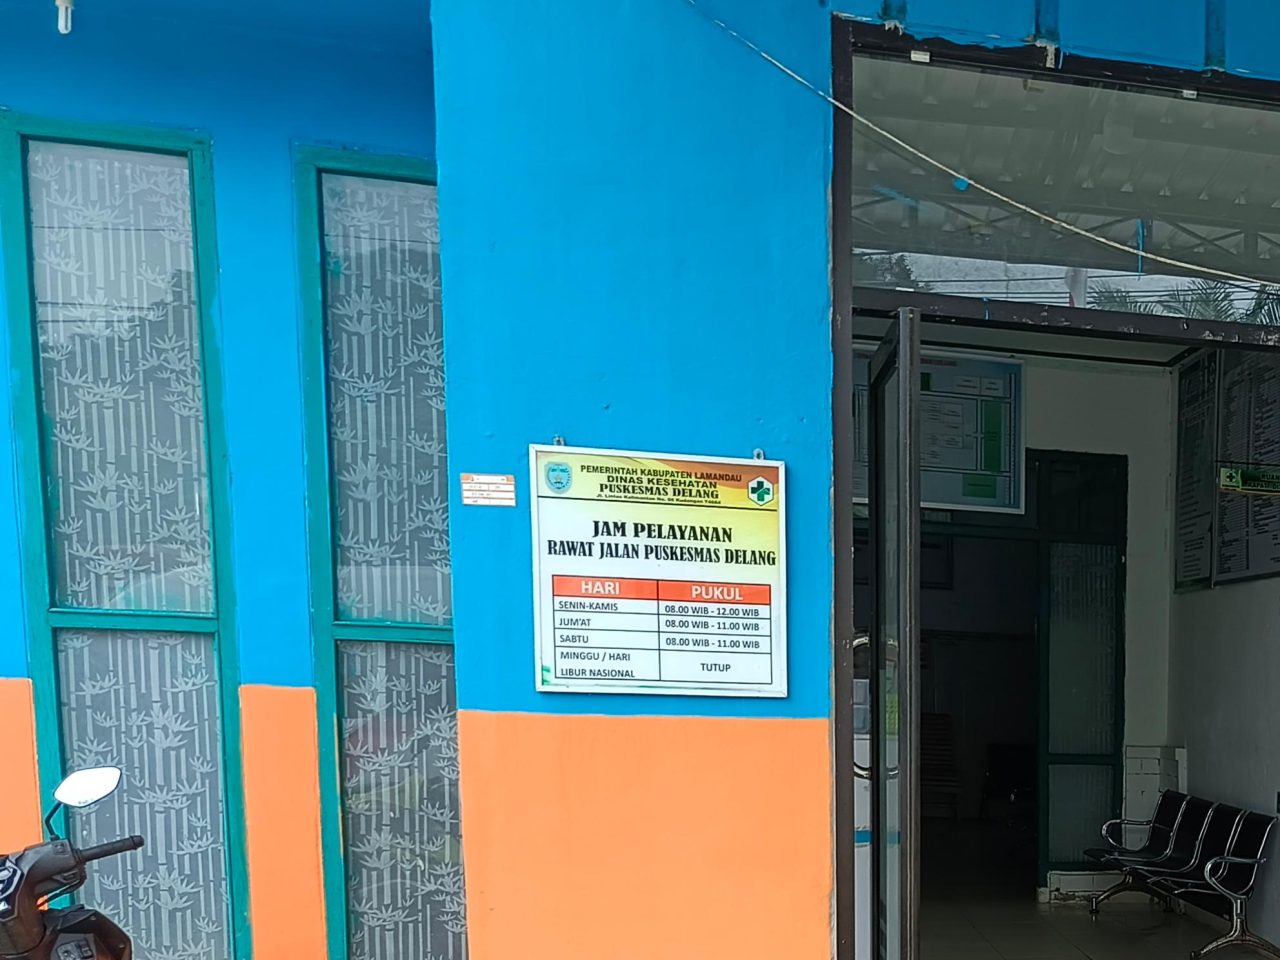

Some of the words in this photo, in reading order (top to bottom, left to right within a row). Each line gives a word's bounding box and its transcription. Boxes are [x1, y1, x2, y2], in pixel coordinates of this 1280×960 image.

[580, 464, 638, 477] PEMERINTAH
[640, 468, 692, 480] KABUPATEN
[694, 471, 742, 483] LAMANDAU
[607, 475, 644, 485] DINAS
[647, 477, 717, 489] KESEHATAN
[599, 483, 669, 497] PUSKESMAS
[672, 487, 719, 499] DELANG
[592, 520, 627, 538] JAM
[633, 522, 733, 543] PELAYANAN
[547, 540, 595, 557] RAWAT
[599, 542, 640, 560] JALAN
[644, 544, 721, 563] PUSKESMAS
[725, 548, 777, 566] DELANG
[581, 580, 620, 595] HARI
[691, 585, 744, 601] PUKUL
[558, 601, 619, 612] SENIN-KAMIS
[665, 605, 690, 615] 08.00
[691, 606, 709, 615] WIB
[716, 607, 740, 616] 12.00
[741, 608, 760, 617] WIB
[665, 619, 690, 629] 08.00
[691, 620, 709, 629] WIB
[716, 621, 740, 631] 11.00
[741, 622, 760, 631] WIB
[559, 634, 589, 644] SABTU
[665, 637, 690, 647] 08.00
[691, 638, 710, 647] WIB
[717, 639, 740, 648] 11.00
[741, 640, 760, 649] WIB
[560, 651, 600, 661] MINGGU
[608, 652, 631, 661] HARI
[560, 668, 587, 678] LIBUR
[589, 669, 635, 679] NASIONAL
[700, 663, 731, 673] TUTUP
